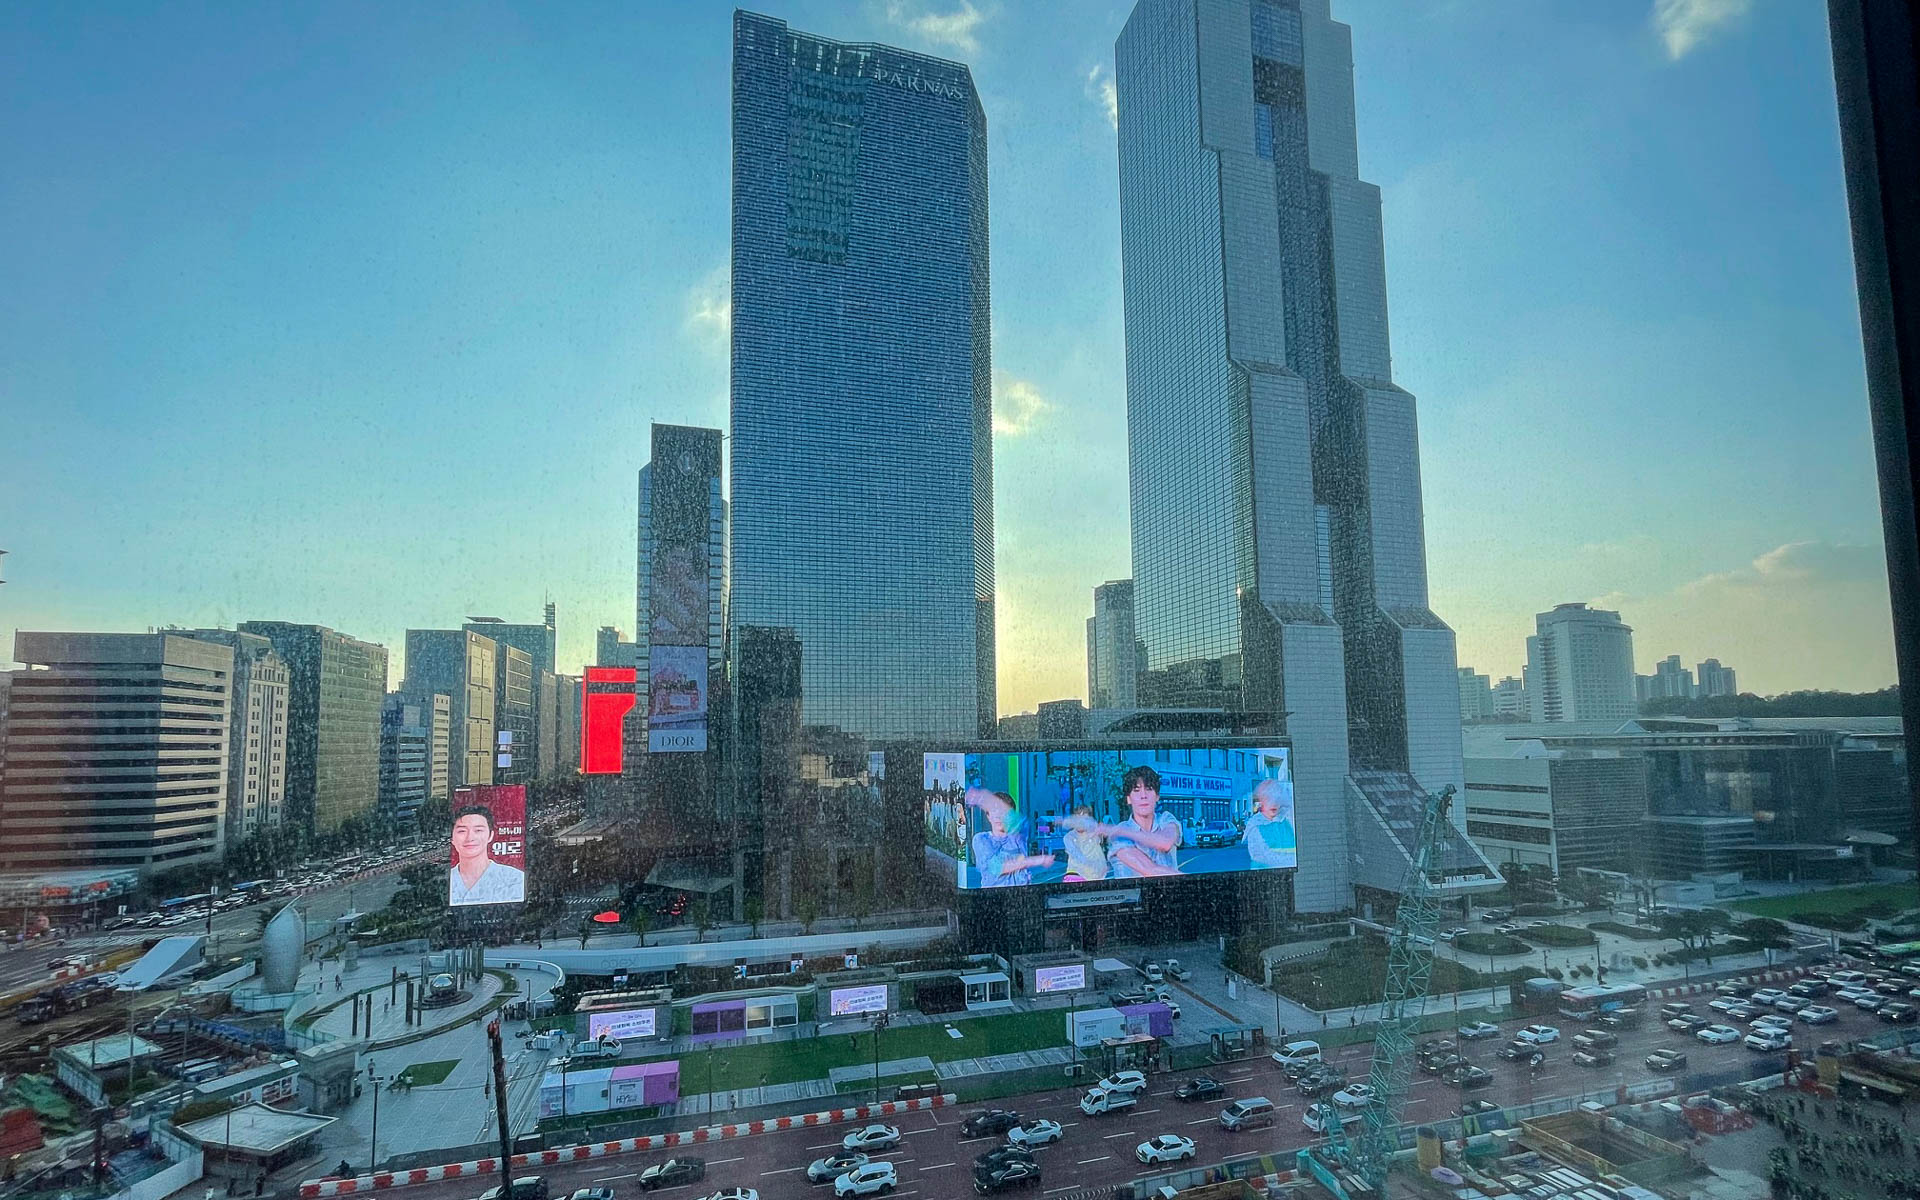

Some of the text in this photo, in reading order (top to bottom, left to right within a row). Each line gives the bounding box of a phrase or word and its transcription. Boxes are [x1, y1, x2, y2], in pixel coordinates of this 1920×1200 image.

[877, 68, 964, 99] PARNAS
[661, 735, 695, 746] DIOR
[1170, 776, 1225, 791] WISH & WASH
[492, 841, 522, 856] 위로
